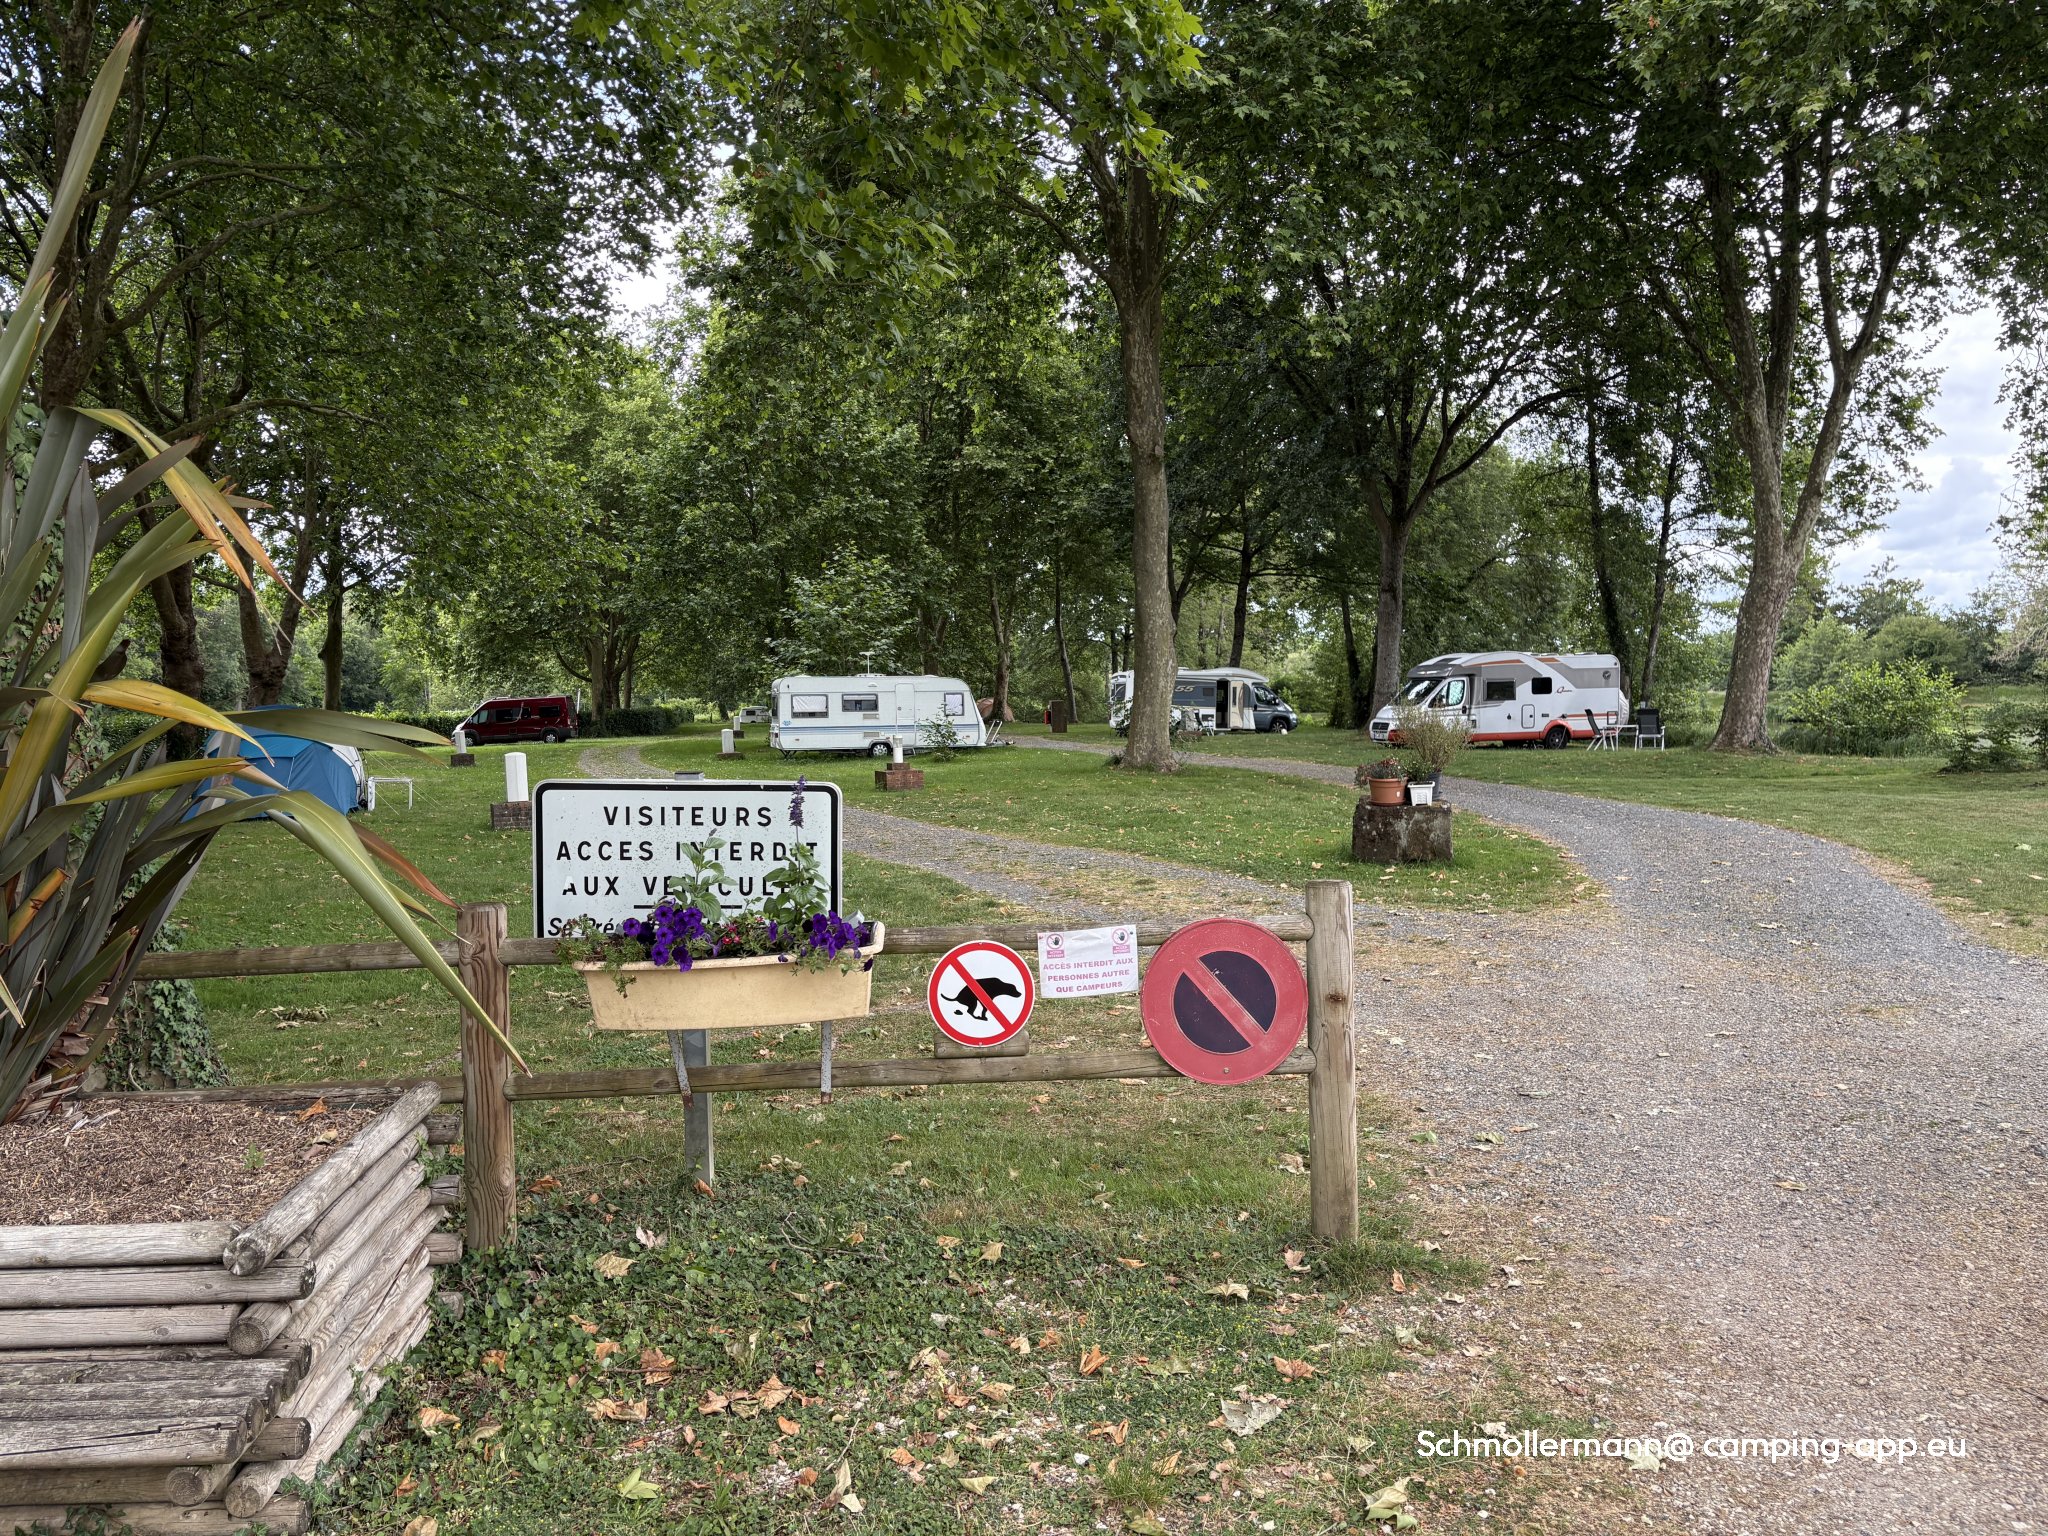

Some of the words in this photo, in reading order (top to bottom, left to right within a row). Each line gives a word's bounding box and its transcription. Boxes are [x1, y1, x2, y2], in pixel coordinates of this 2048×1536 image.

[603, 805, 773, 827] VISITEURS
[556, 840, 654, 861] ACCES
[676, 841, 818, 861] IERDT
[562, 876, 619, 896] AUX
[642, 876, 816, 897] VECUL
[1074, 959, 1113, 969] INTERDIT
[1048, 973, 1099, 982] PERSONNES
[1102, 969, 1130, 978] AUTRE
[1076, 981, 1123, 992] CAMPEURS
